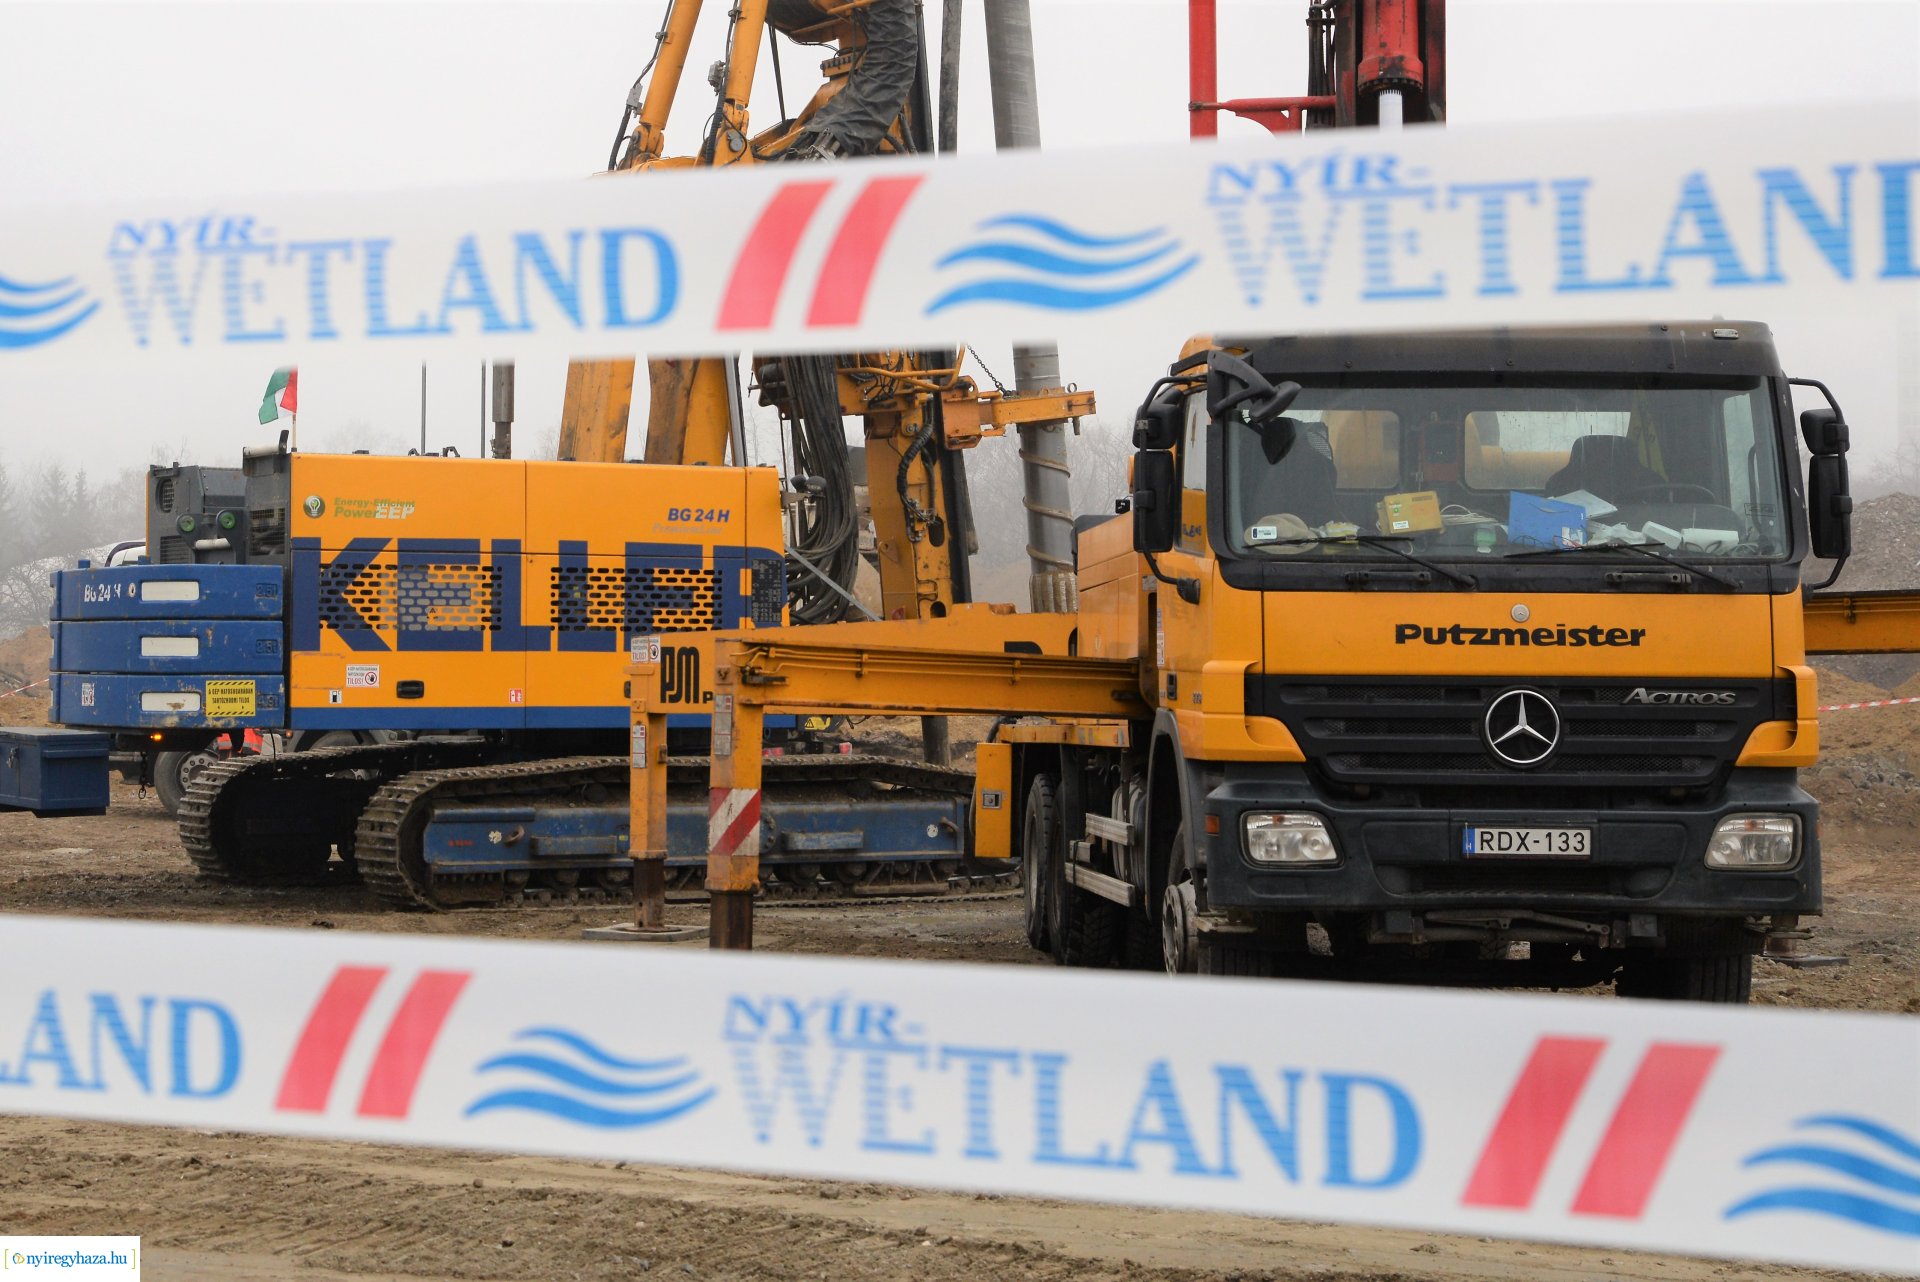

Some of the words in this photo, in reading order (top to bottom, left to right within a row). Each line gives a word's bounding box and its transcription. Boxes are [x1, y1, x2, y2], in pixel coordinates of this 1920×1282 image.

[107, 226, 682, 347] WETLAND
[334, 505, 379, 518] Power
[668, 508, 692, 522] BG
[694, 508, 715, 523] 24
[717, 509, 730, 523] H
[1395, 622, 1646, 648] Putzmeister
[1480, 831, 1585, 852] RDX-133
[0, 987, 244, 1099] AND
[724, 1034, 1424, 1190] WETLAND
